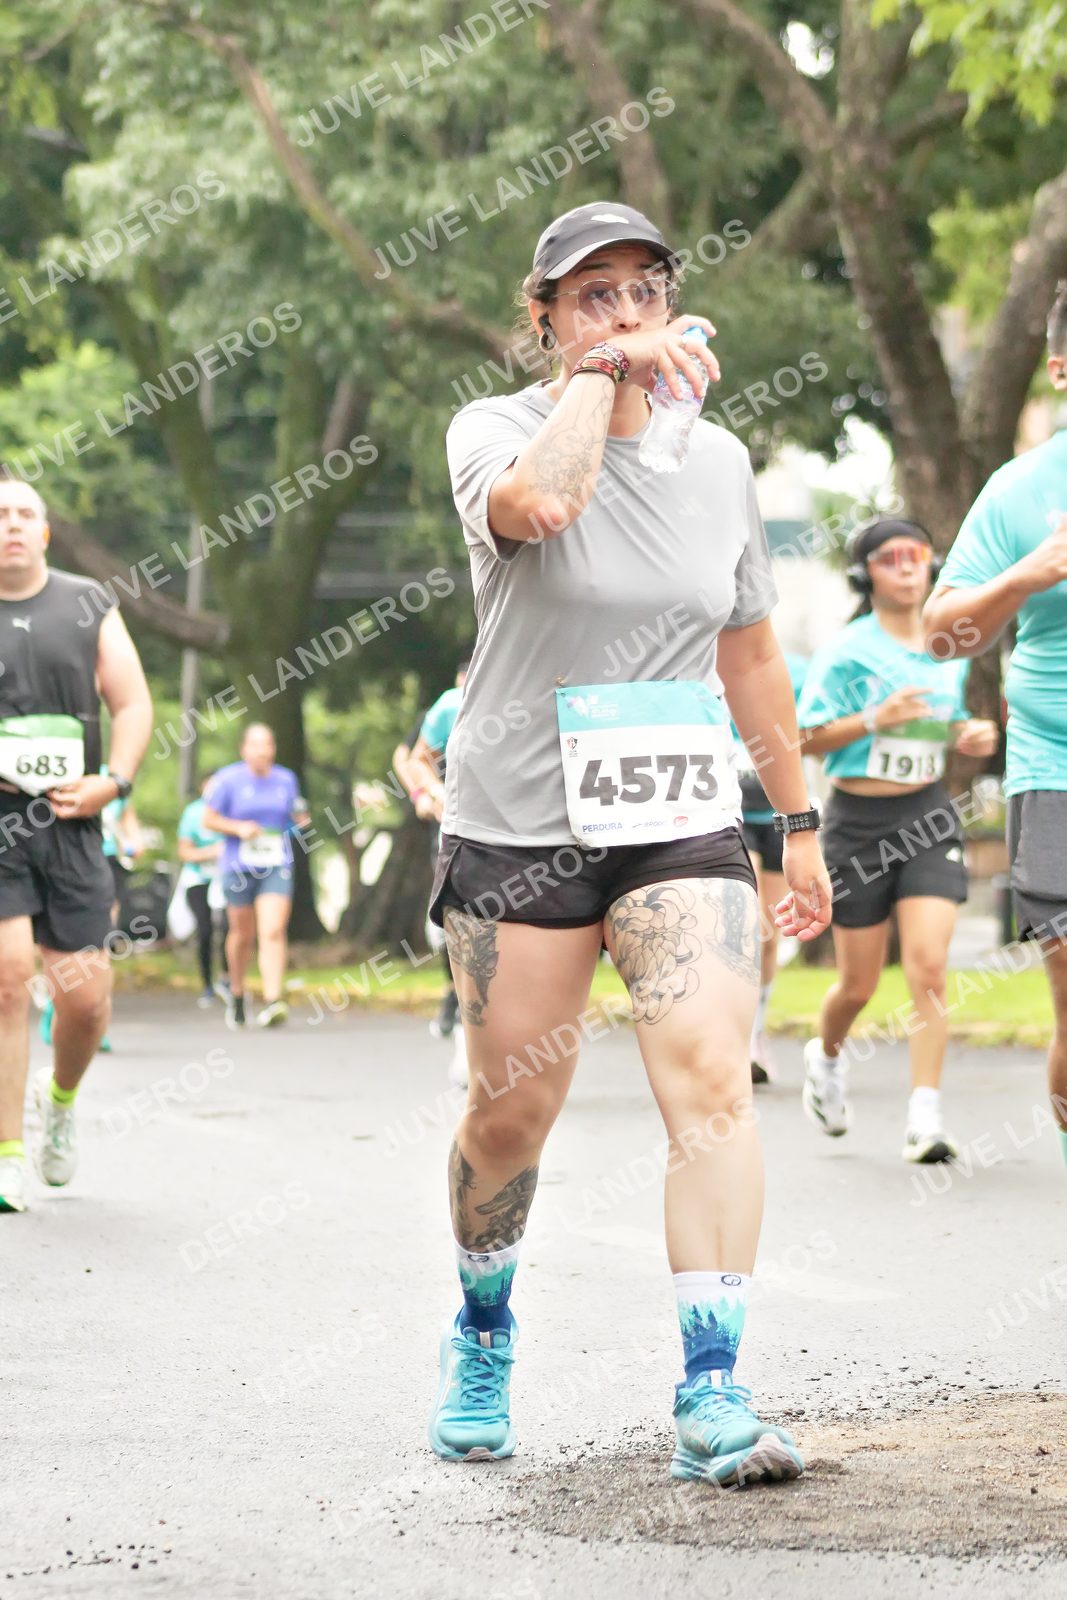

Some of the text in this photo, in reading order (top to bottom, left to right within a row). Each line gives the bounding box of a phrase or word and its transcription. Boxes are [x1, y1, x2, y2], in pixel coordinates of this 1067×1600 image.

[16, 754, 67, 777] 683
[579, 754, 719, 807] 4573
[582, 821, 623, 833] PERDURA
